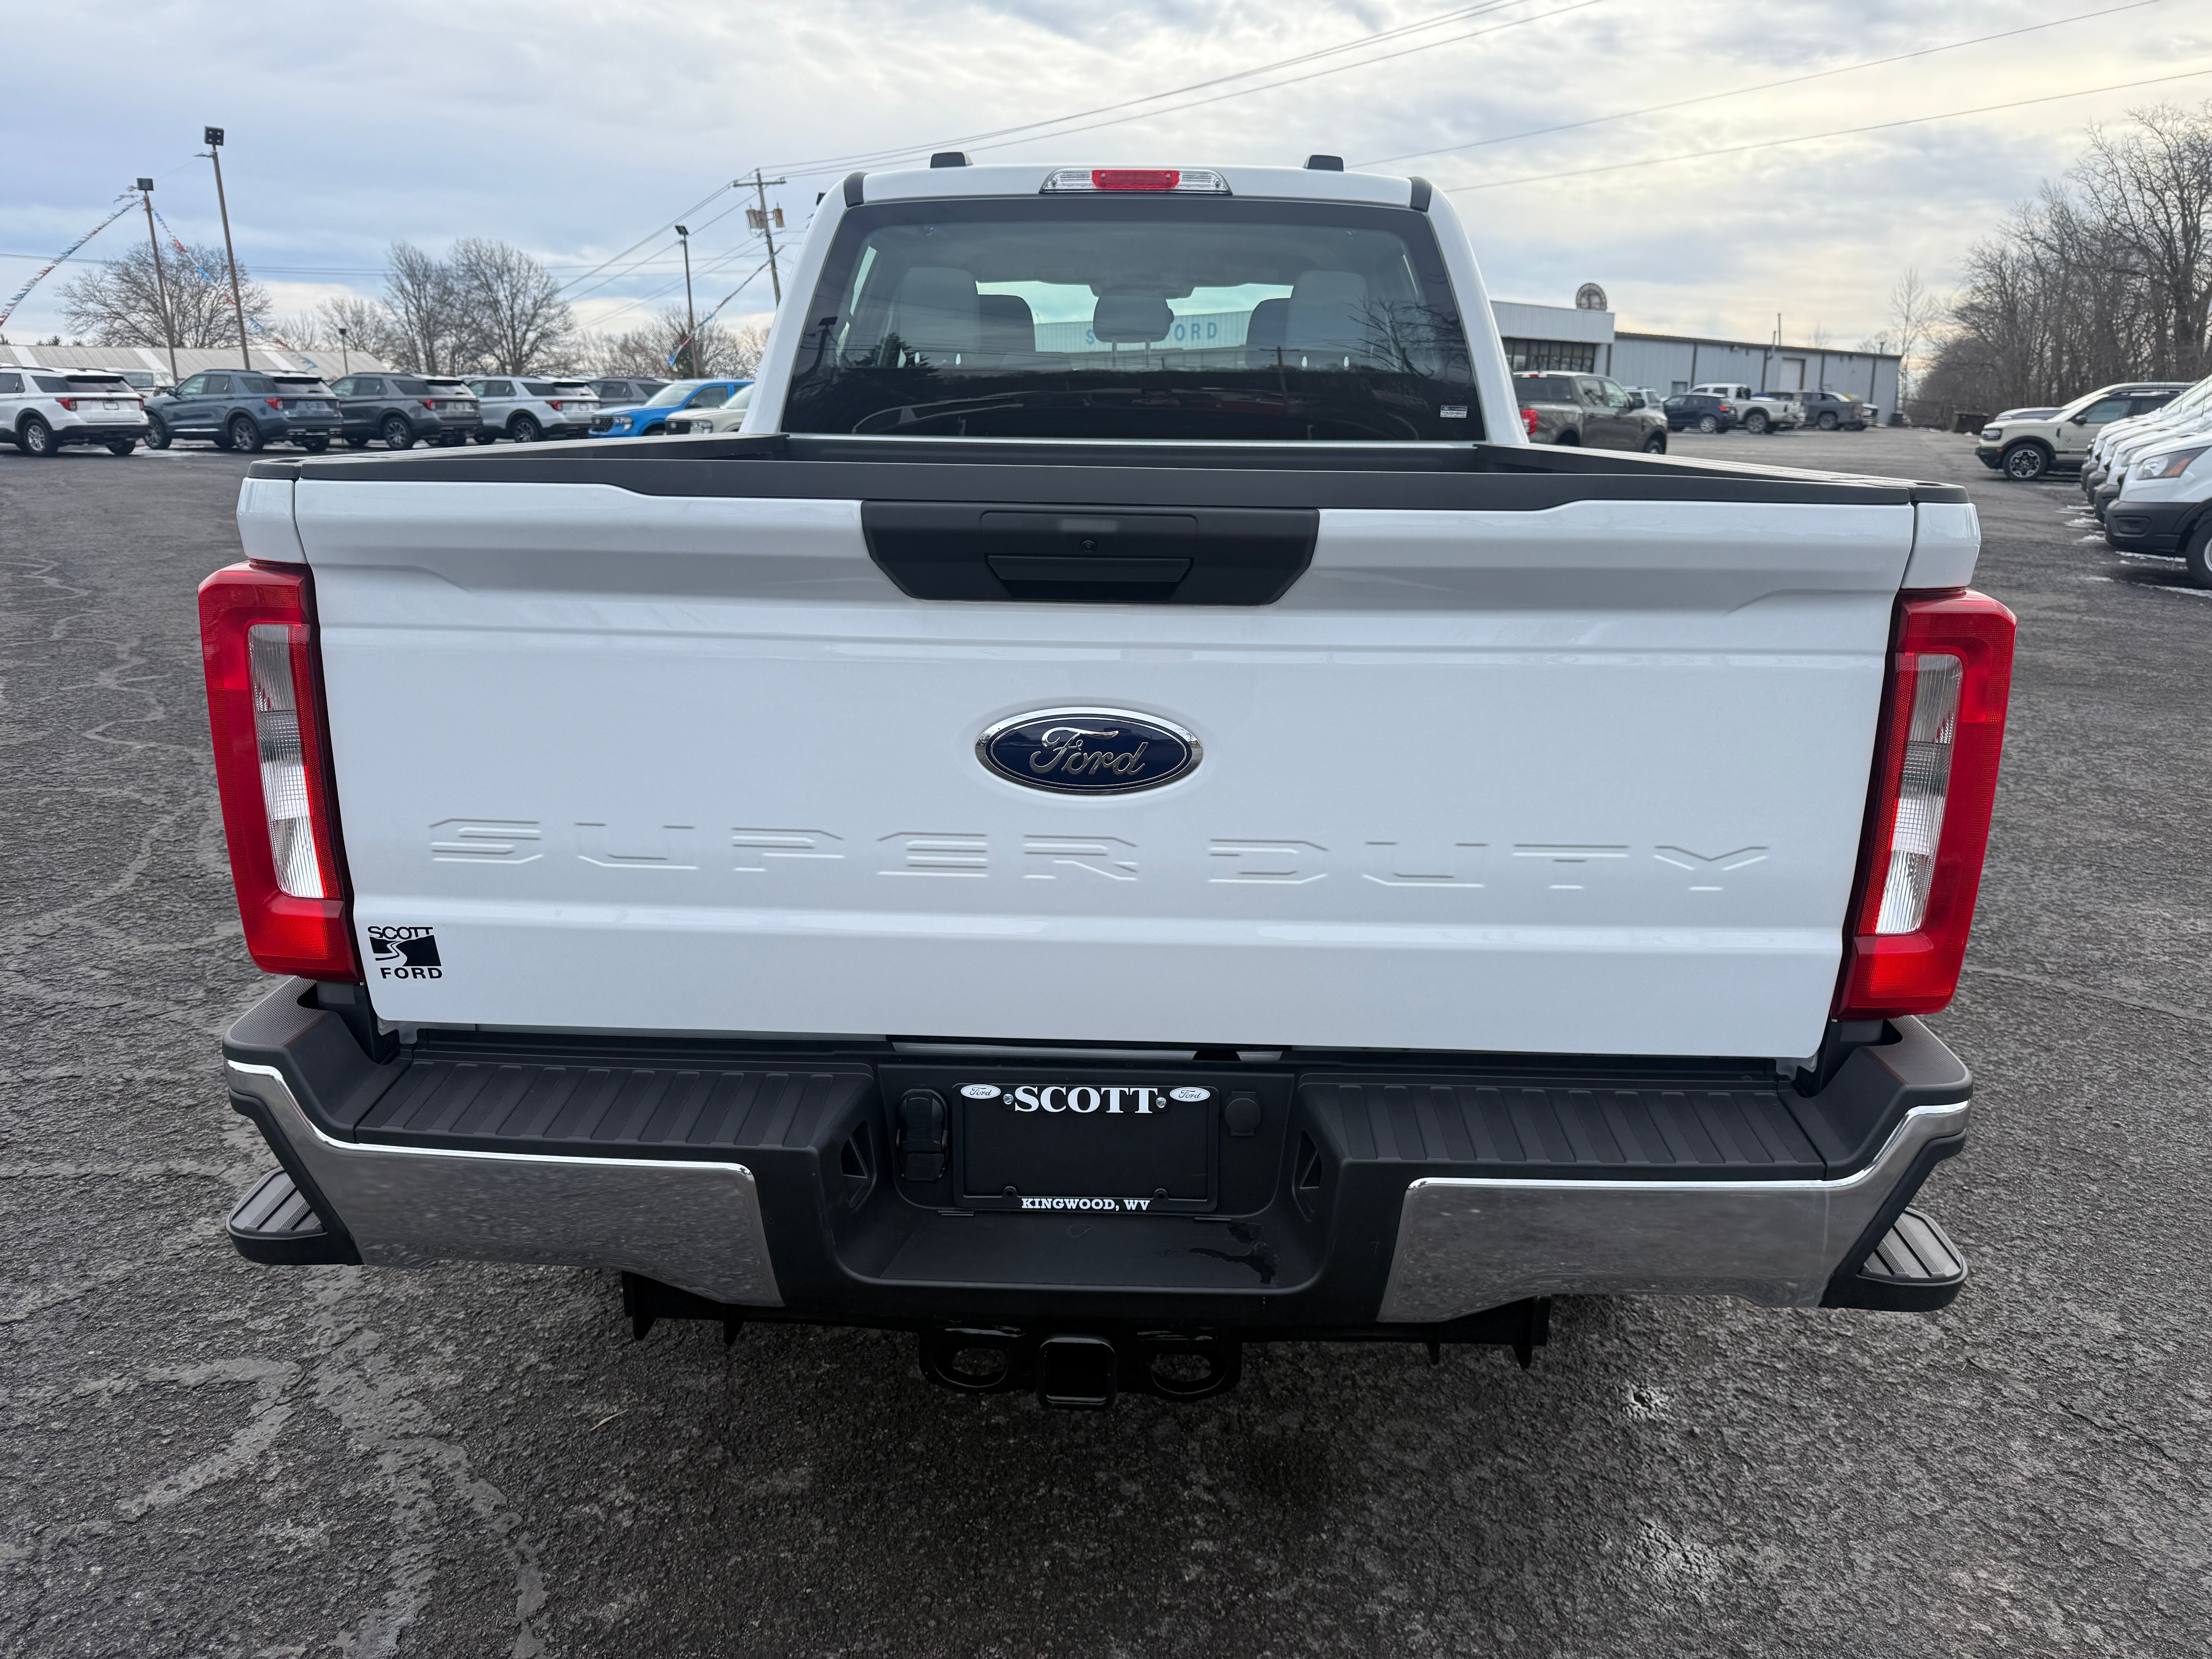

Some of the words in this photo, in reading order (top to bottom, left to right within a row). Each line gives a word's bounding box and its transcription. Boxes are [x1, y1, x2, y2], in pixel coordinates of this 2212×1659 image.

[1174, 322, 1218, 341] ORD
[1029, 726, 1149, 775] Ford
[429, 818, 1138, 881] SUPER
[1208, 839, 1770, 891] DUTY
[368, 926, 433, 940] SCOTT
[380, 967, 442, 979] FORD
[970, 1087, 992, 1096] Ford
[1178, 1090, 1201, 1099] Ford
[1014, 1086, 1158, 1114] SCOTT
[1021, 1198, 1119, 1211] KINGWOOD,
[1124, 1199, 1151, 1211] WV
